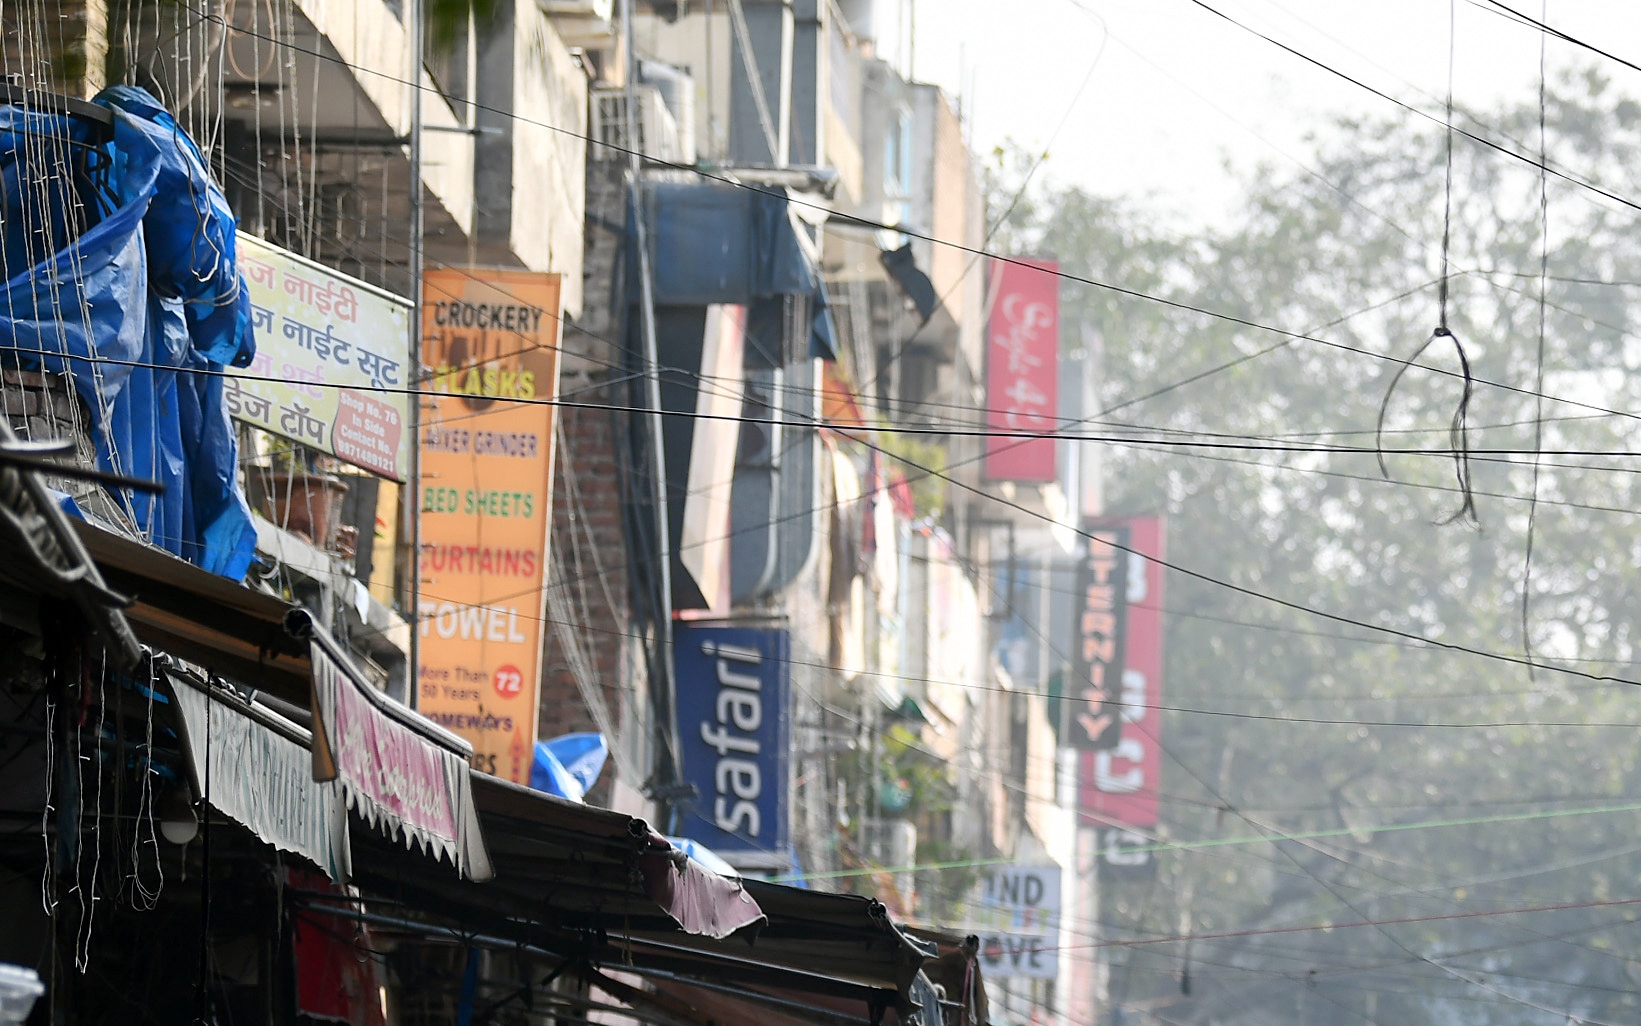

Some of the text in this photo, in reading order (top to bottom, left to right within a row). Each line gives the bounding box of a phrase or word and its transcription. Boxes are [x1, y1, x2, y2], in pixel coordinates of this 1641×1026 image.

[434, 300, 543, 333] CROCKERY
[282, 316, 351, 365] नाईट
[433, 364, 536, 400] FLASKS
[340, 391, 364, 413] Shop
[280, 402, 326, 446] टॉप
[341, 424, 376, 449] Contact
[364, 418, 386, 437] Side
[473, 430, 538, 459] GRINDER
[423, 487, 534, 519] BED SHEETS
[419, 544, 536, 579] CURTAINS
[418, 601, 526, 644] TOWEL
[1075, 530, 1119, 742] ETERNITY
[455, 666, 488, 683] Than
[494, 671, 521, 693] 72
[442, 684, 481, 700] Years
[701, 639, 763, 838] safari
